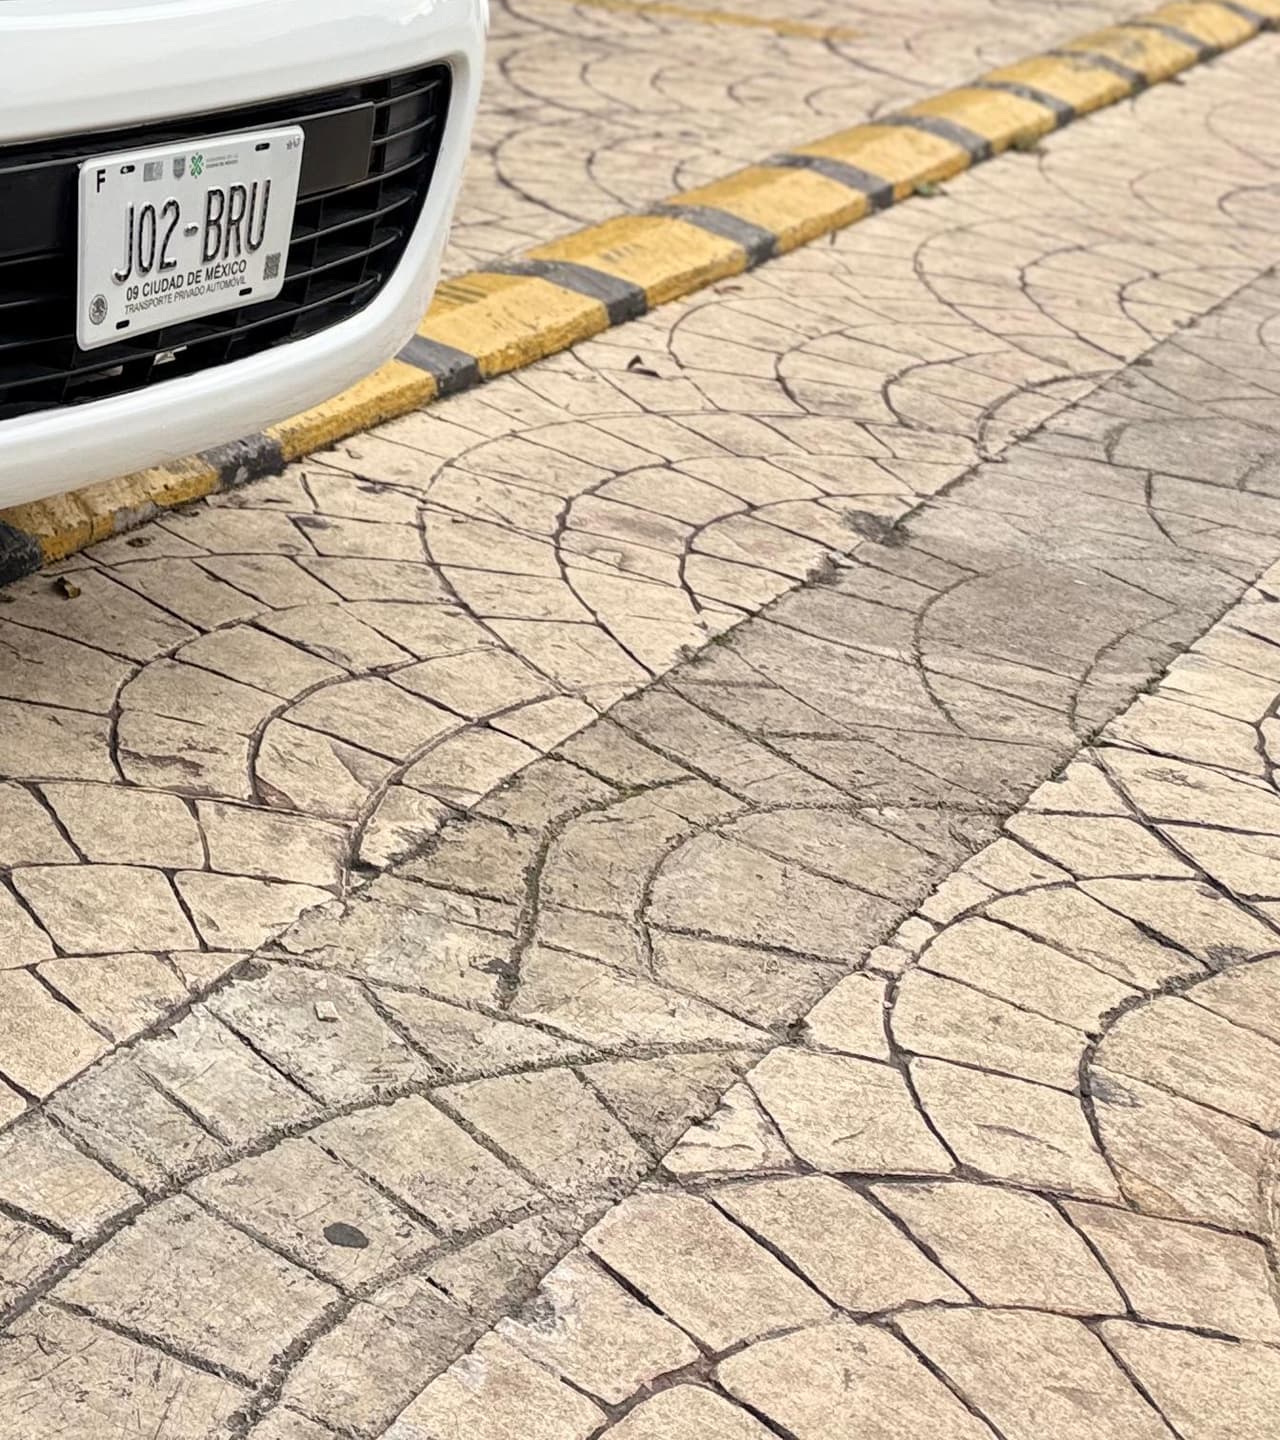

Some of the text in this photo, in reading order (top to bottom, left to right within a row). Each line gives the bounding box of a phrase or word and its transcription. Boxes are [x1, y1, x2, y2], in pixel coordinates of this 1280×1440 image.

[96, 169, 106, 193] F
[111, 179, 271, 285] J02-BRU
[126, 259, 247, 301] 09 CIUDAD DE MÉXICO
[125, 292, 172, 314] TRANSPORTE
[174, 285, 205, 301] PRIVADO
